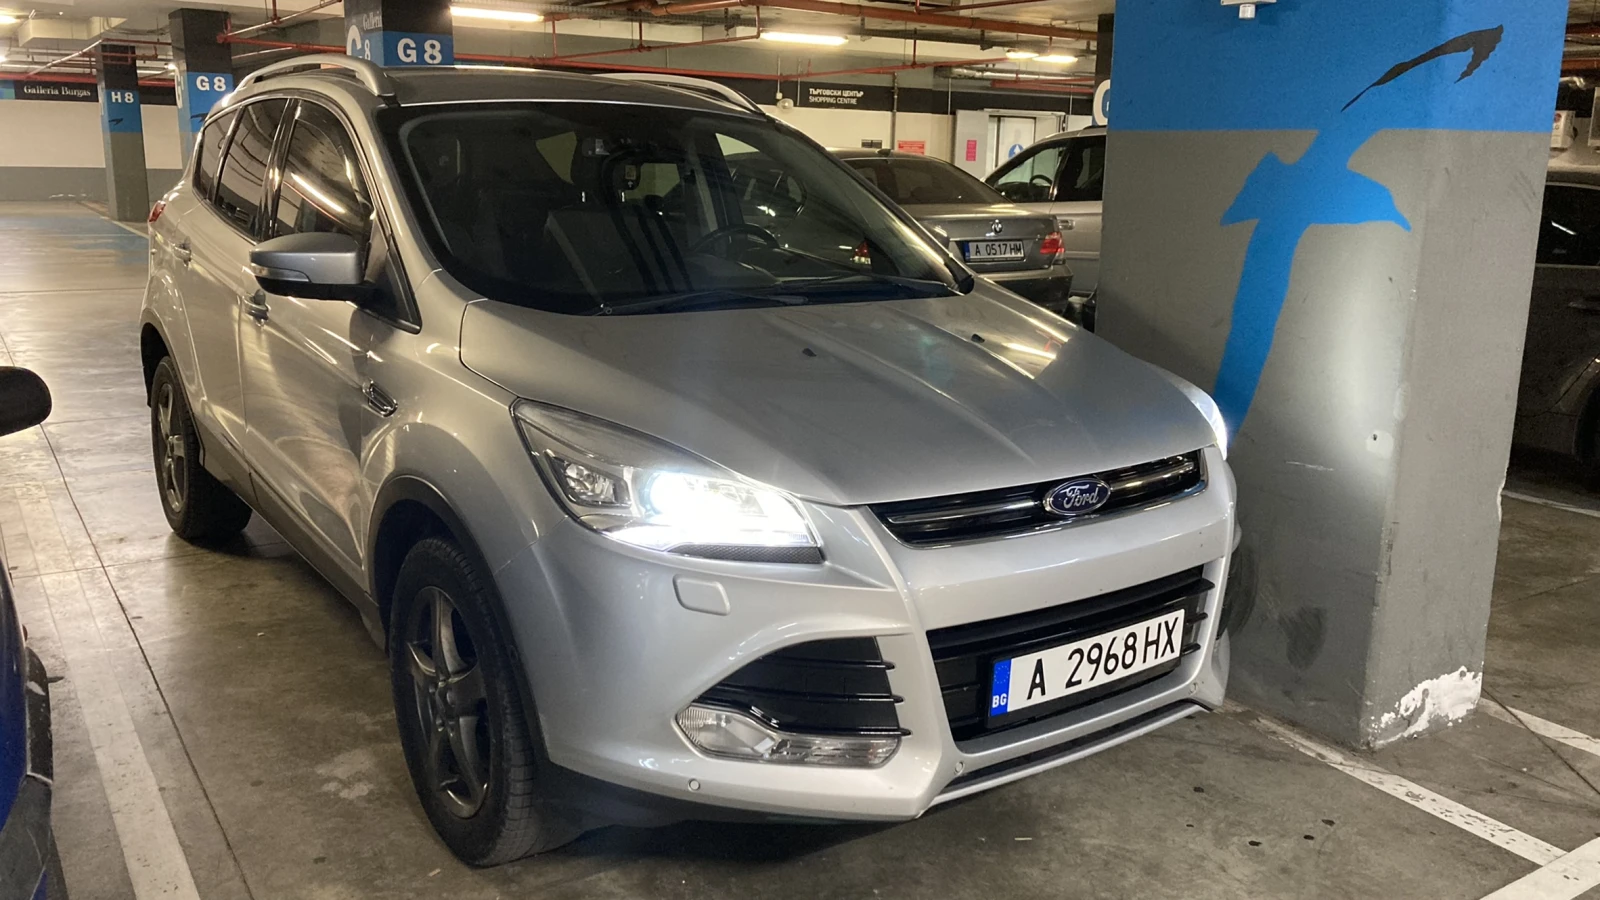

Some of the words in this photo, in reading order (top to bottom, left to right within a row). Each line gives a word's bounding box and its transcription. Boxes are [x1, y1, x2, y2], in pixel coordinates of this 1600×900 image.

[23, 85, 59, 95] Galleria
[61, 86, 91, 98] Burgas
[809, 95, 836, 103] SHOPPING
[837, 97, 857, 105] CENTRE
[1060, 484, 1100, 509] Ford
[992, 693, 1007, 708] BG
